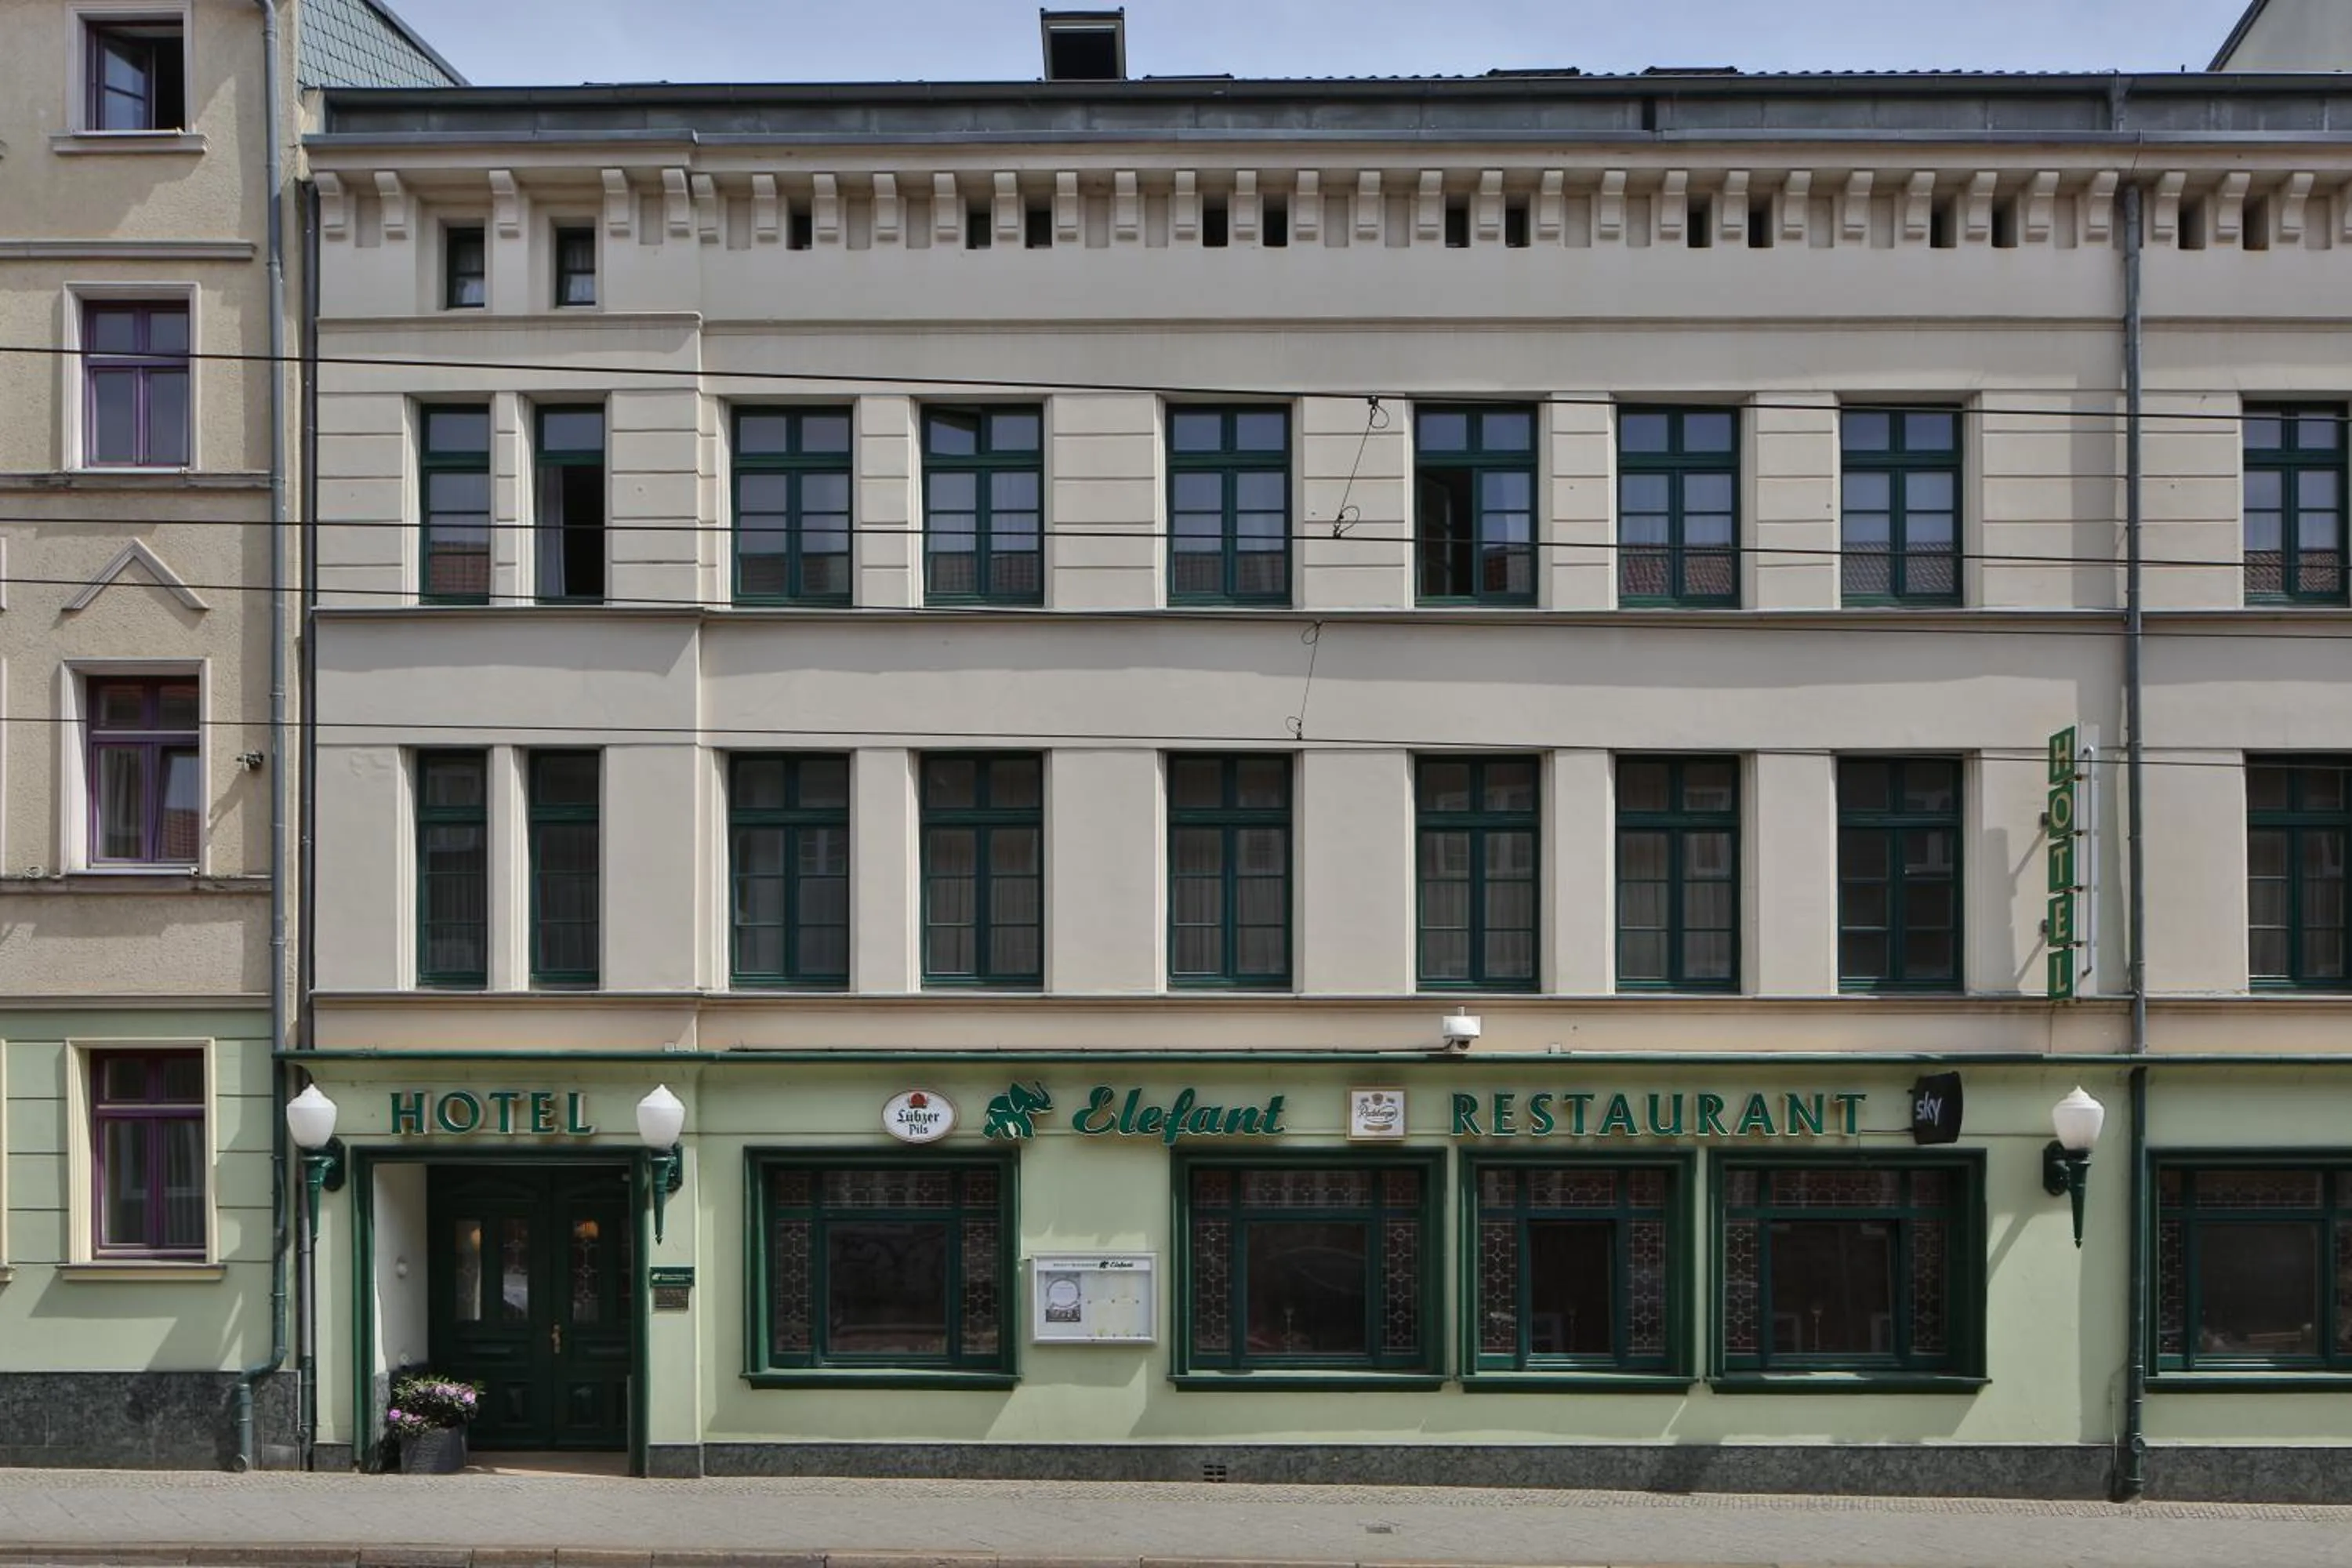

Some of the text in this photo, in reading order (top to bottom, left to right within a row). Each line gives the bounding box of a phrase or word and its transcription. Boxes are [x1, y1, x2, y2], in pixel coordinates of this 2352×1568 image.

[2050, 733, 2072, 993] HOTEL
[390, 1091, 597, 1134] HOTEL
[909, 1124, 928, 1135] Pils
[1072, 1086, 1285, 1145] Elefant
[1450, 1093, 1867, 1136] RESTAURANT
[1916, 1091, 1942, 1127] sky
